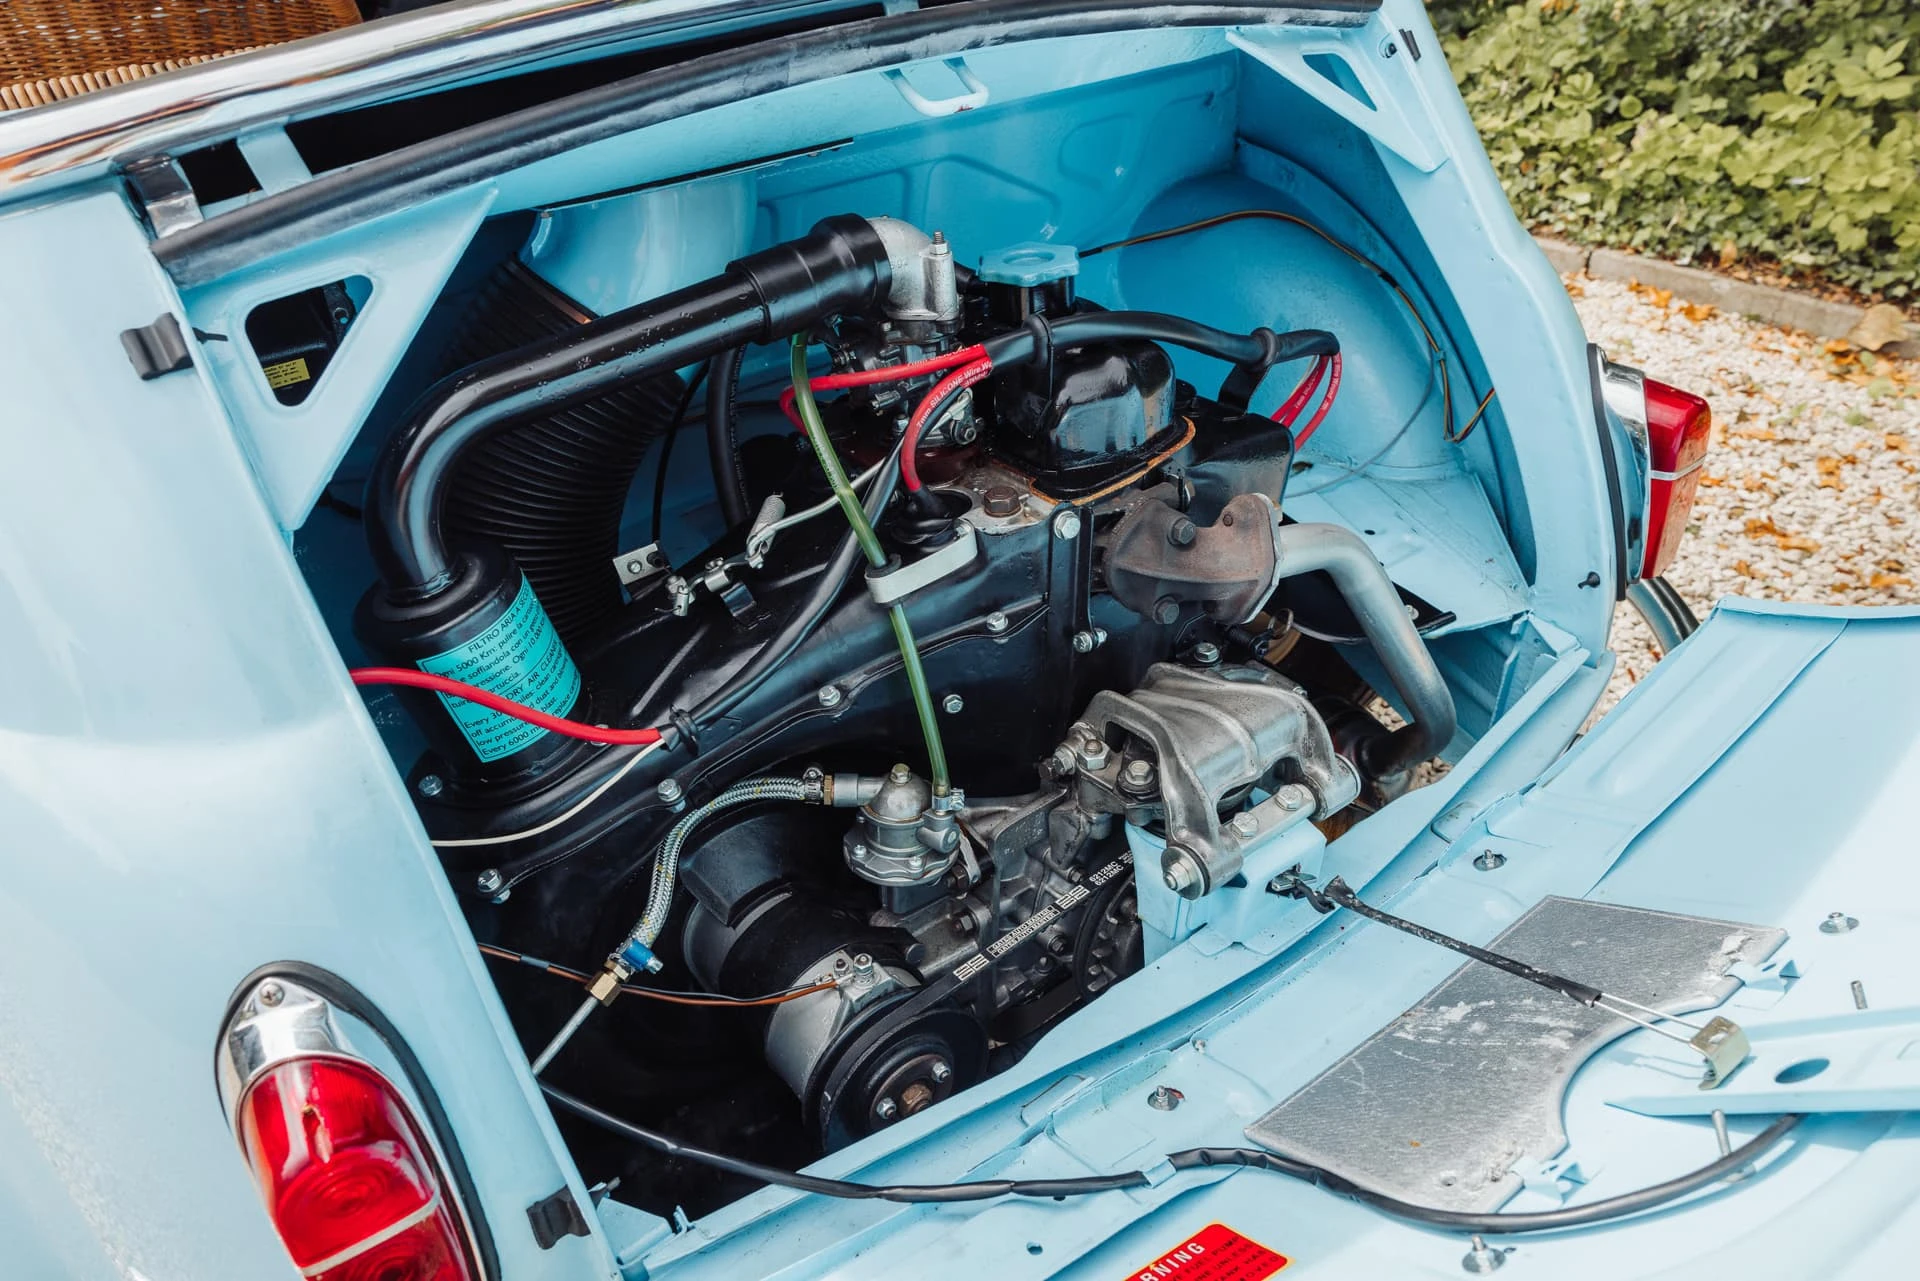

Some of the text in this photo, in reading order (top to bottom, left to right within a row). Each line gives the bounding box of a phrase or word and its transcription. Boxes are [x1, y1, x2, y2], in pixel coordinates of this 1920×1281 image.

[930, 375, 965, 408] SILICONE
[455, 656, 479, 672] 5000
[498, 628, 518, 649] pulire
[468, 628, 500, 653] FILTRO
[501, 613, 517, 631] ARIA
[468, 650, 511, 679] soffiandola
[511, 638, 523, 651] con
[473, 665, 512, 687] ressione.
[512, 648, 528, 664] Ogni
[464, 717, 489, 728] Every
[536, 673, 550, 690] clean
[505, 684, 524, 700] DRY
[528, 671, 540, 686] AIR
[471, 729, 483, 738] off
[536, 690, 549, 704] dust
[475, 738, 493, 746] low
[494, 721, 529, 742] pressur
[482, 744, 507, 756] Every
[508, 731, 528, 746] 6000
[1089, 861, 1118, 881] 6212MC
[1094, 865, 1124, 885] 6212MC
